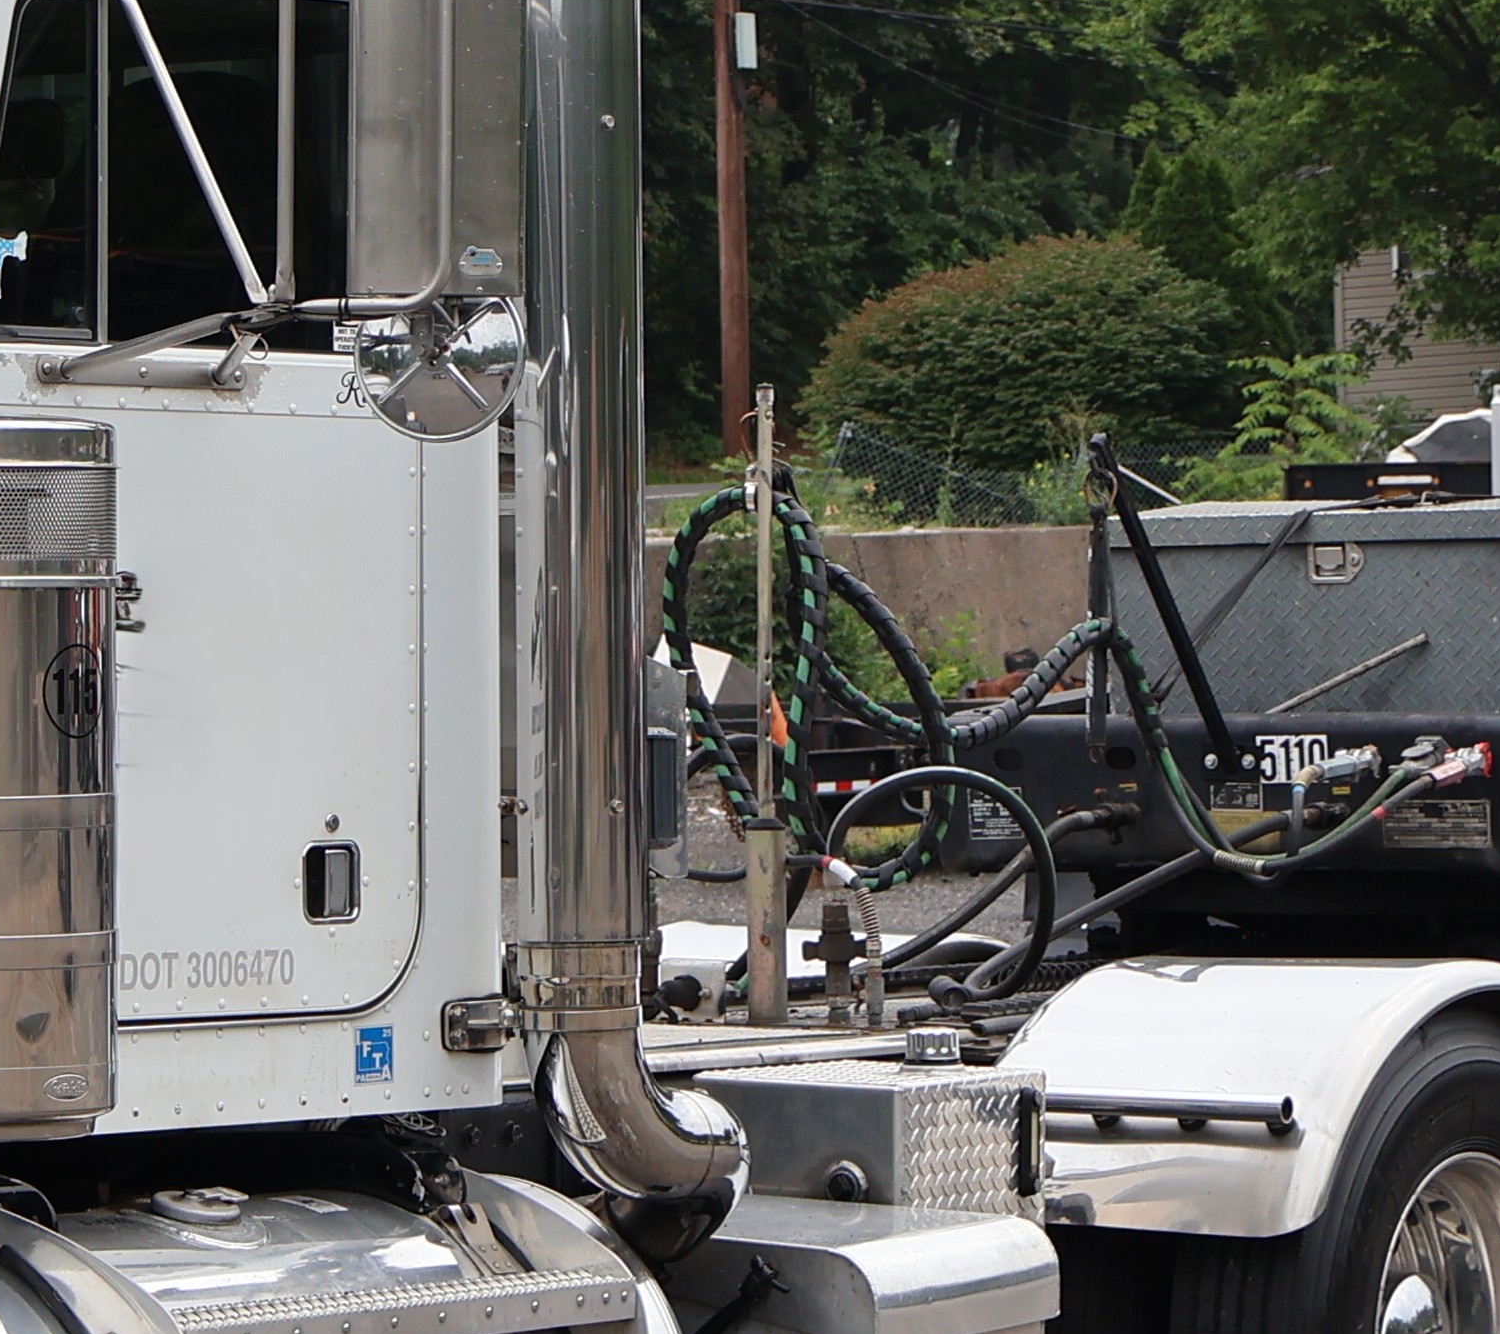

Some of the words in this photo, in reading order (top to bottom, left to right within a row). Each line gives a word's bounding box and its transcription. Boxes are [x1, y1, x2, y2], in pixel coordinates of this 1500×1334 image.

[53, 668, 98, 715] 115
[1258, 736, 1325, 784] 5110
[119, 952, 179, 990] DOT
[186, 948, 295, 989] 3006470
